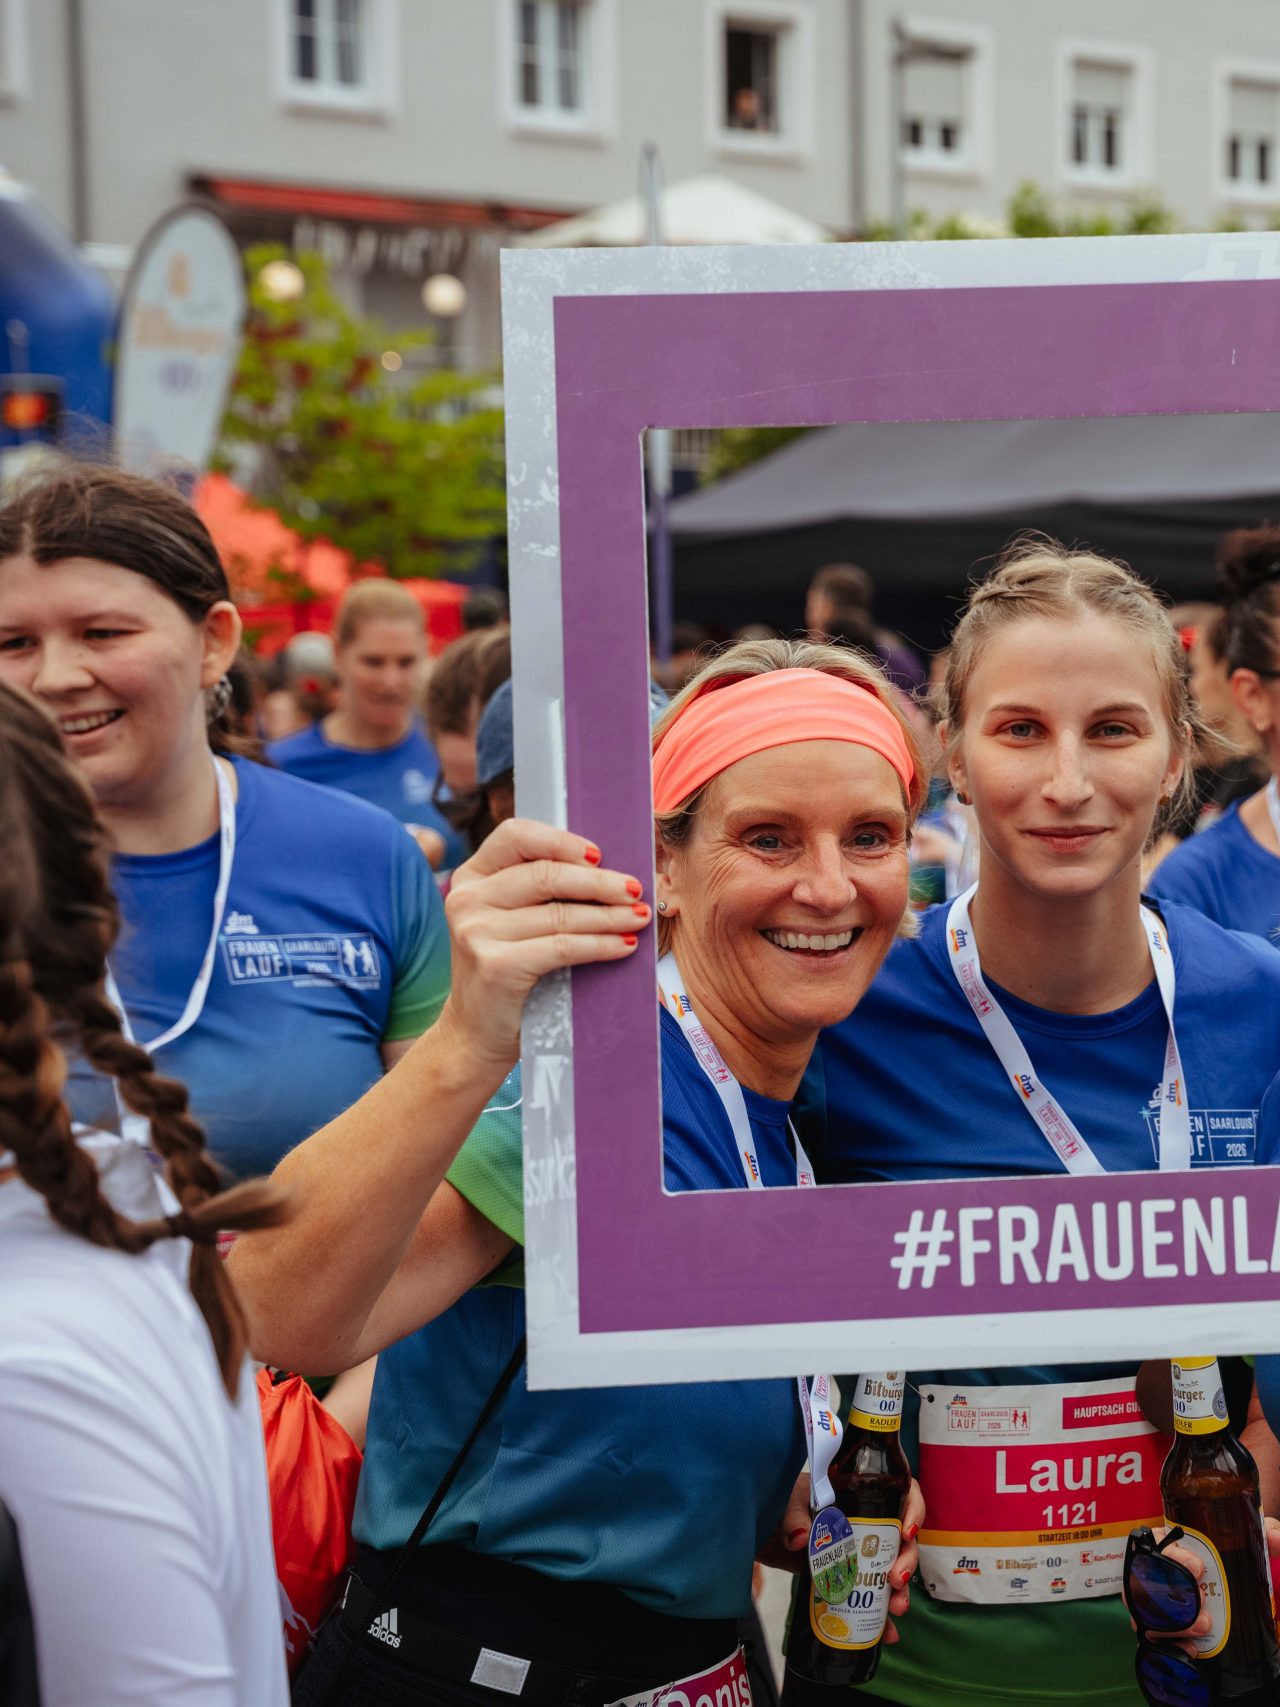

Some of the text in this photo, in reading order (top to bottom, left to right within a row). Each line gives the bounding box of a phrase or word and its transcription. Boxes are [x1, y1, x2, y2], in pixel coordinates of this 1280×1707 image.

[956, 929, 968, 948] dm
[232, 955, 285, 978] LAUF
[690, 1029, 707, 1047] LAUF
[1020, 1074, 1035, 1093] dm
[1166, 1083, 1176, 1102] dm
[1210, 1117, 1254, 1130] SAARLOUIS
[1226, 1143, 1247, 1157] 2026
[749, 1155, 759, 1177] dm
[951, 1410, 977, 1418] FRAUEN
[980, 1410, 1009, 1418] SAARLOUIS
[1074, 1403, 1125, 1420] HAUPTSACH
[818, 1411, 831, 1431] dm
[869, 1418, 897, 1426] RADLER
[951, 1418, 977, 1430] LAUF
[996, 1450, 1143, 1494] Laura
[1042, 1501, 1097, 1527] 1121
[816, 1523, 830, 1539] dm
[1038, 1532, 1072, 1543] STARTZEIT
[1090, 1528, 1102, 1538] UHR
[812, 1545, 844, 1571] FRAUENLAUF
[957, 1556, 978, 1568] dm
[1094, 1552, 1124, 1562] Kaufland
[847, 1590, 874, 1609] 0.0
